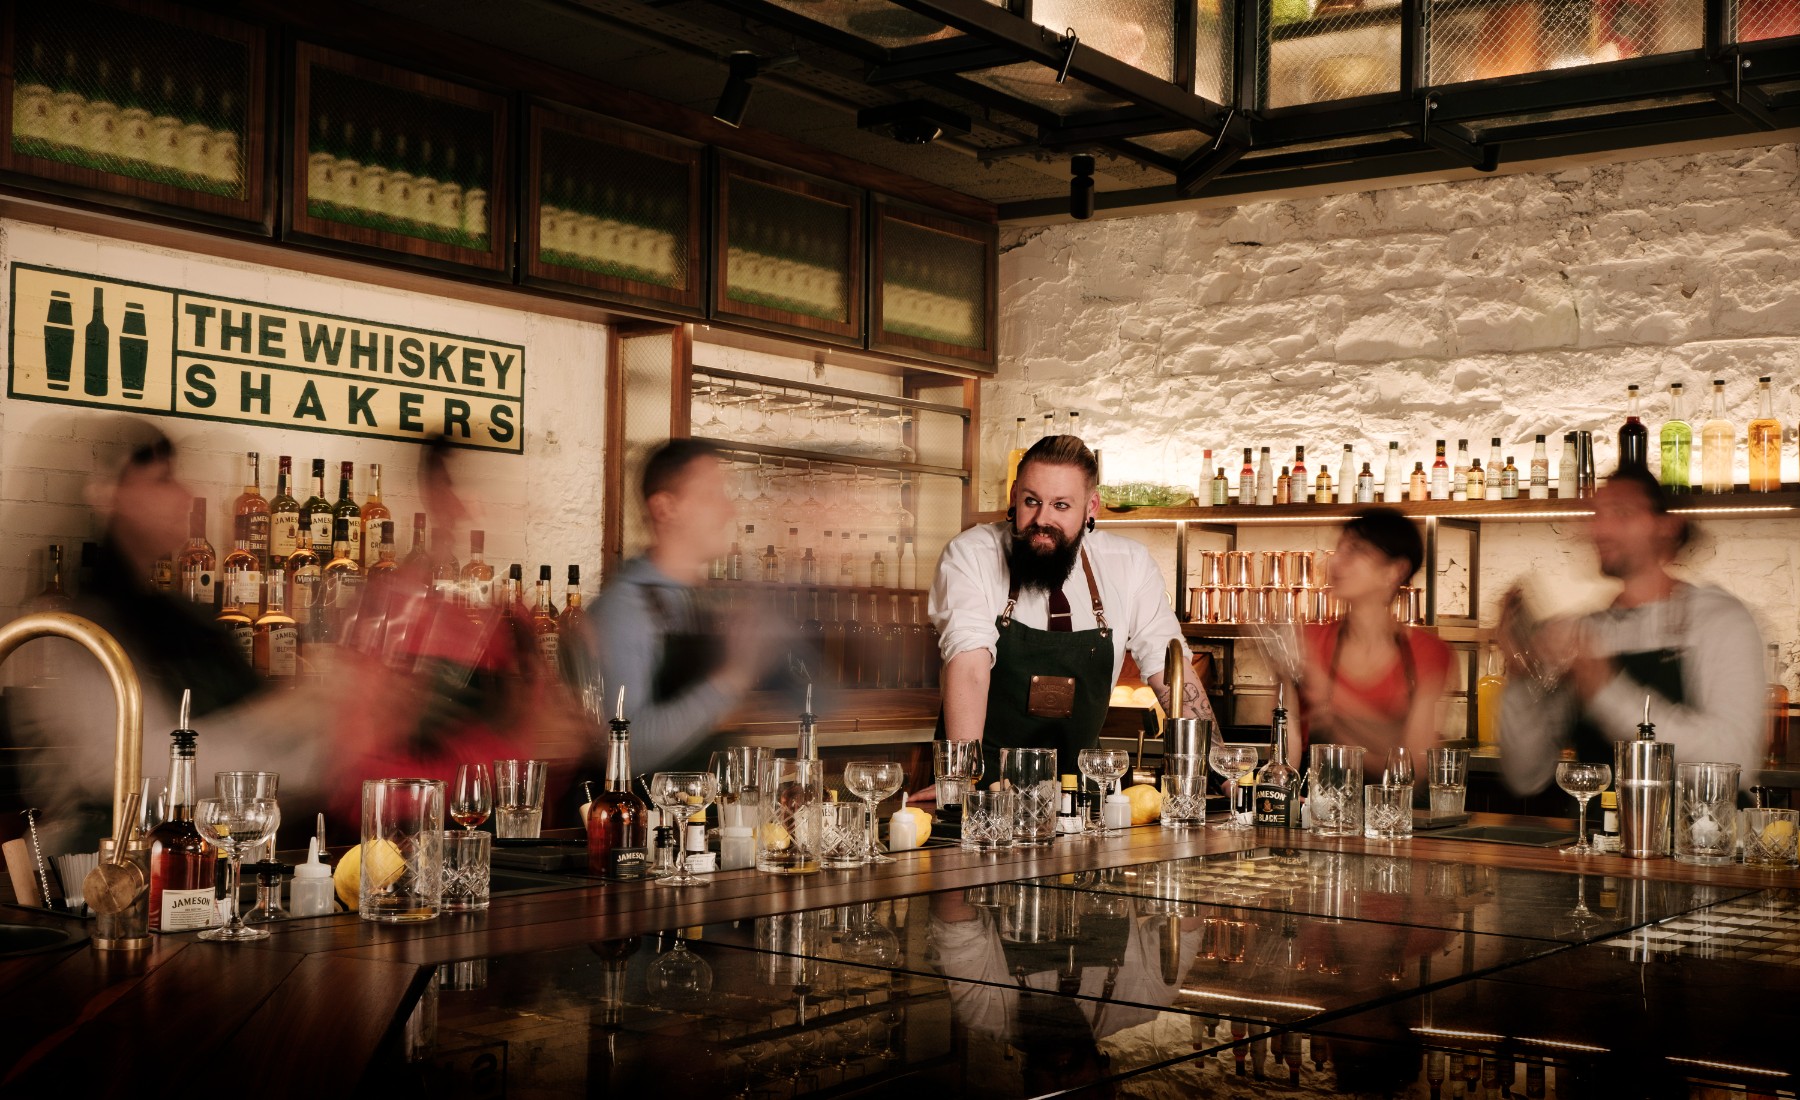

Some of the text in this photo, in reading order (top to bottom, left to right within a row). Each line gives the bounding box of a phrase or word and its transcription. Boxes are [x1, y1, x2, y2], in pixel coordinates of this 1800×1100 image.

[184, 303, 516, 391] THE WHISKEY
[183, 363, 515, 443] SHAKERS
[274, 516, 298, 525] JAMES
[312, 517, 332, 525] AMES
[1256, 790, 1287, 802] AMESON
[1258, 813, 1278, 823] BLACK
[616, 852, 645, 863] JAMESON
[171, 896, 211, 909] JAMESON
